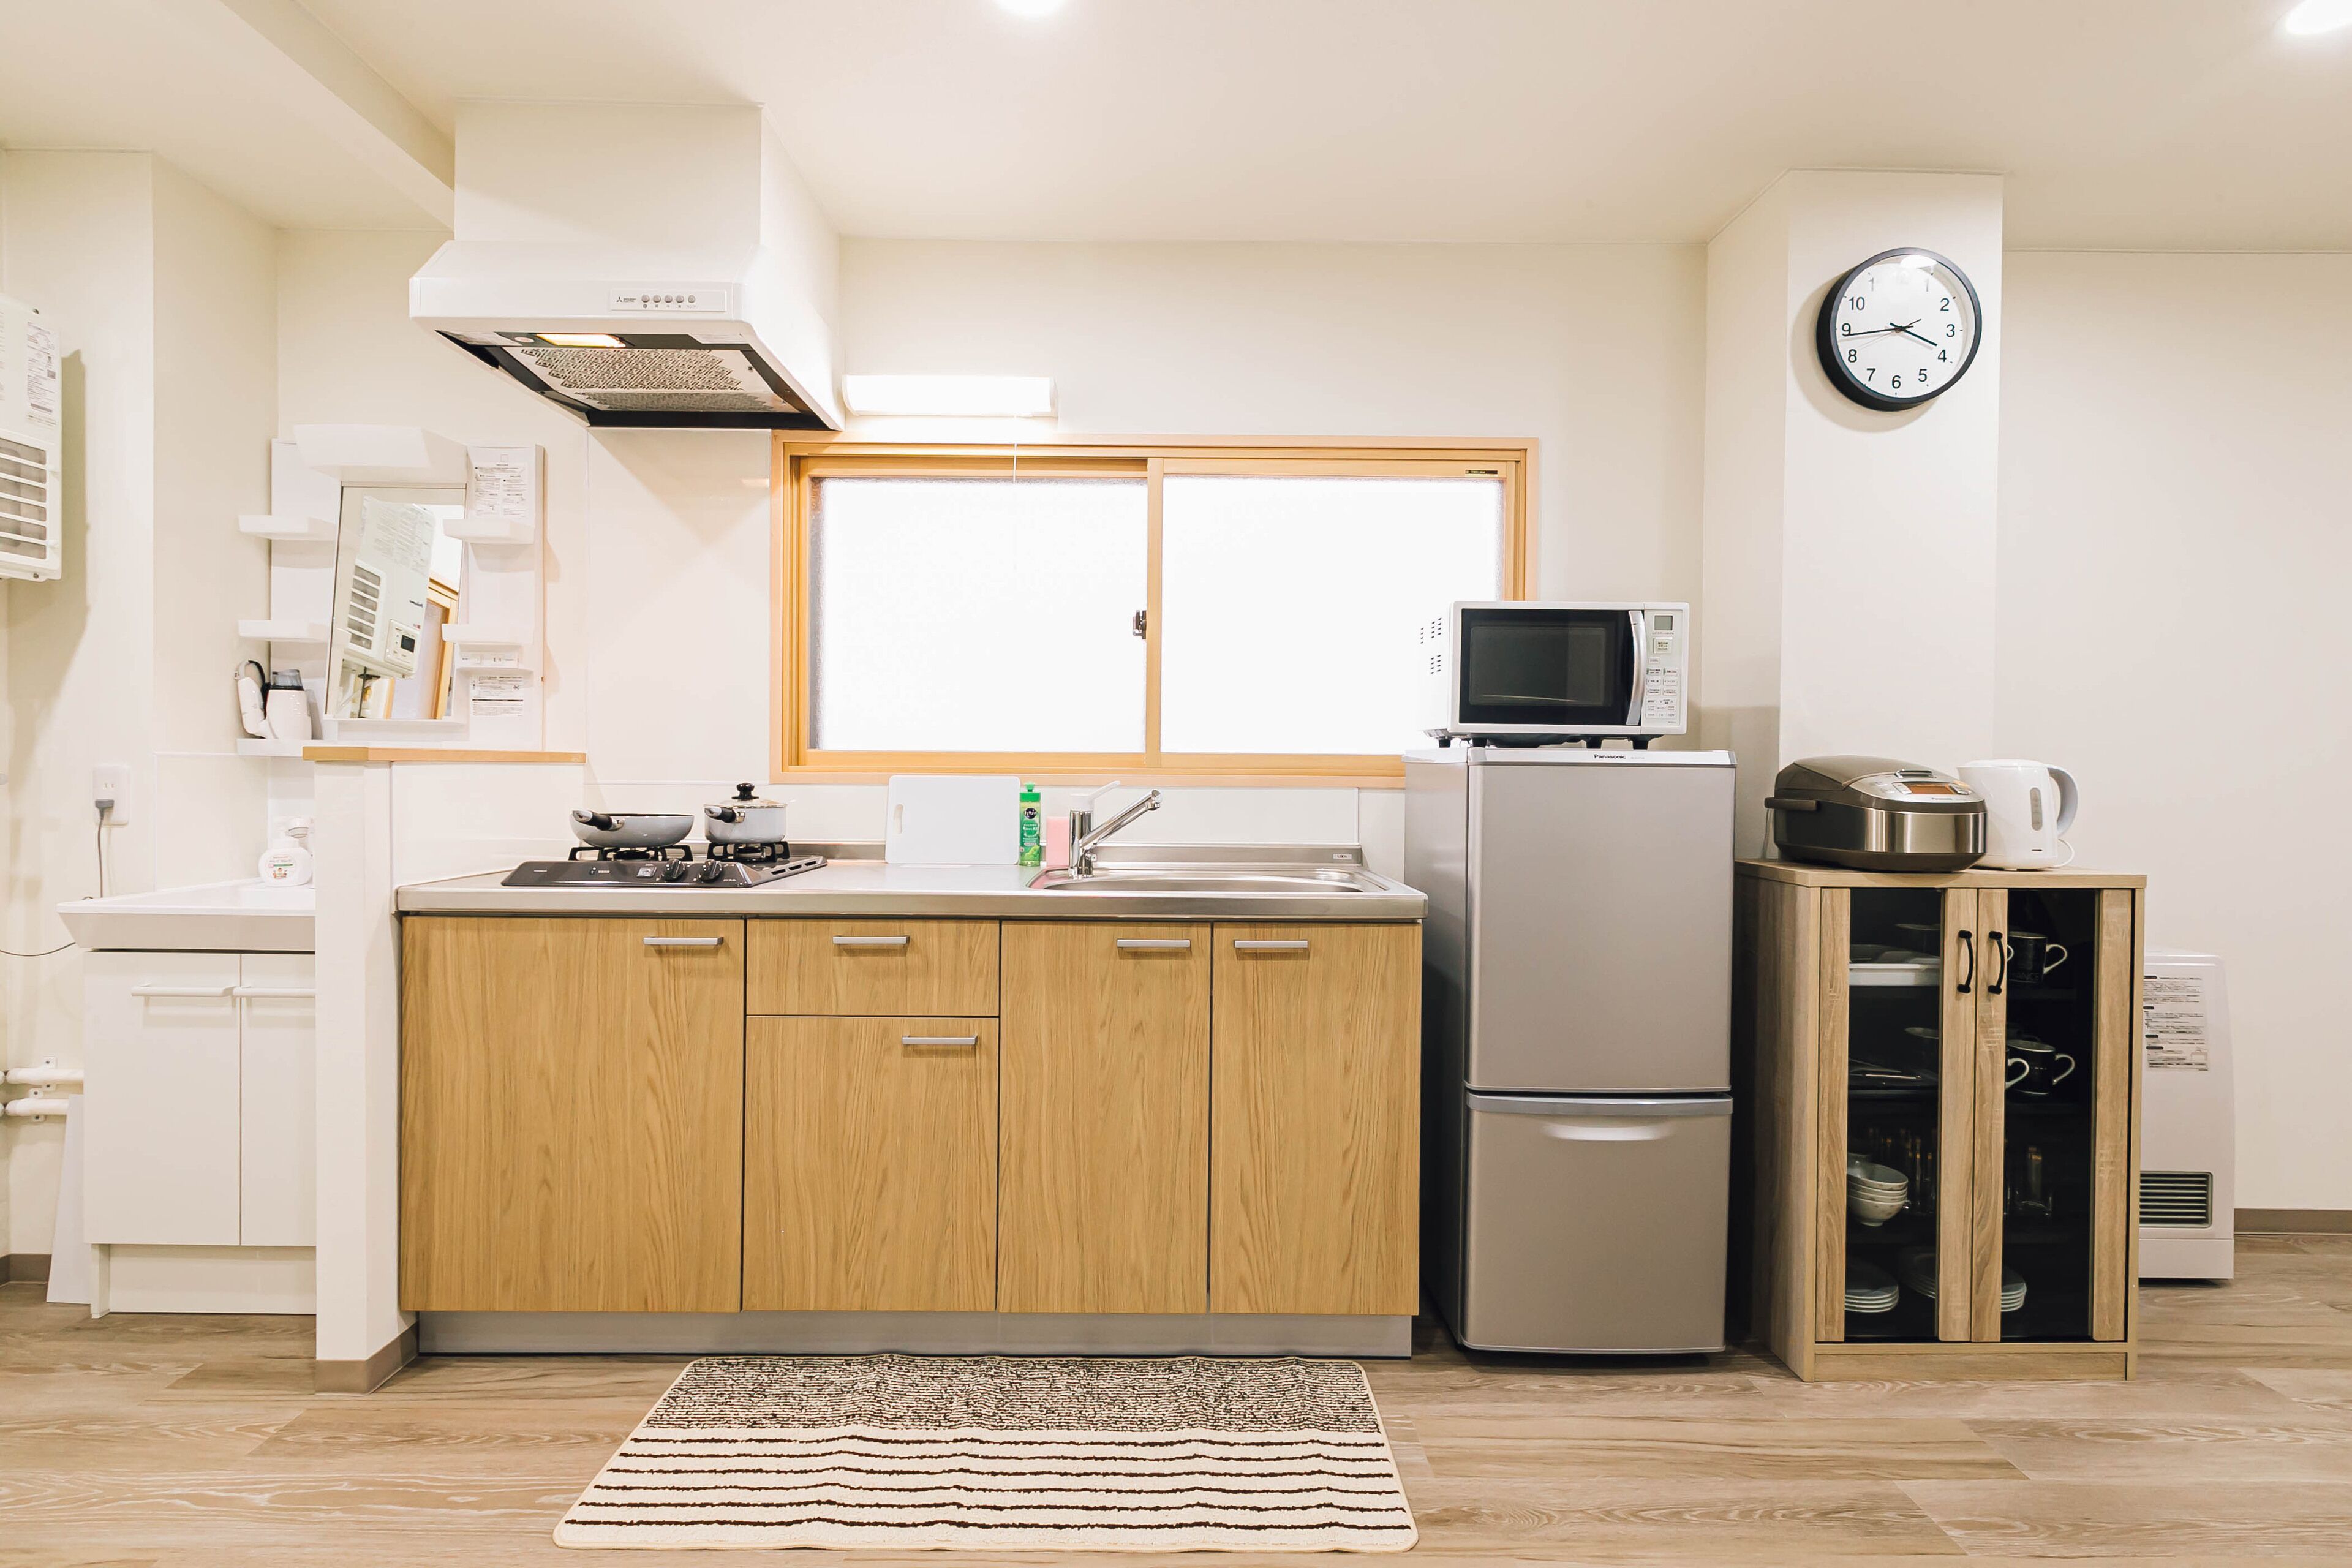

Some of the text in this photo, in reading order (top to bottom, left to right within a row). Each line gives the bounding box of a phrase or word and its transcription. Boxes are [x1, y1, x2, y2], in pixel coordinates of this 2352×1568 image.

[1848, 296, 1865, 311] 10
[1940, 298, 1950, 311] 2
[1841, 322, 1852, 337] 9
[1946, 323, 1955, 337] 3
[1847, 349, 1858, 363] 8
[1937, 349, 1947, 363] 4
[1866, 368, 1876, 382] 7
[1891, 375, 1901, 389] 6
[1918, 368, 1928, 382] 5
